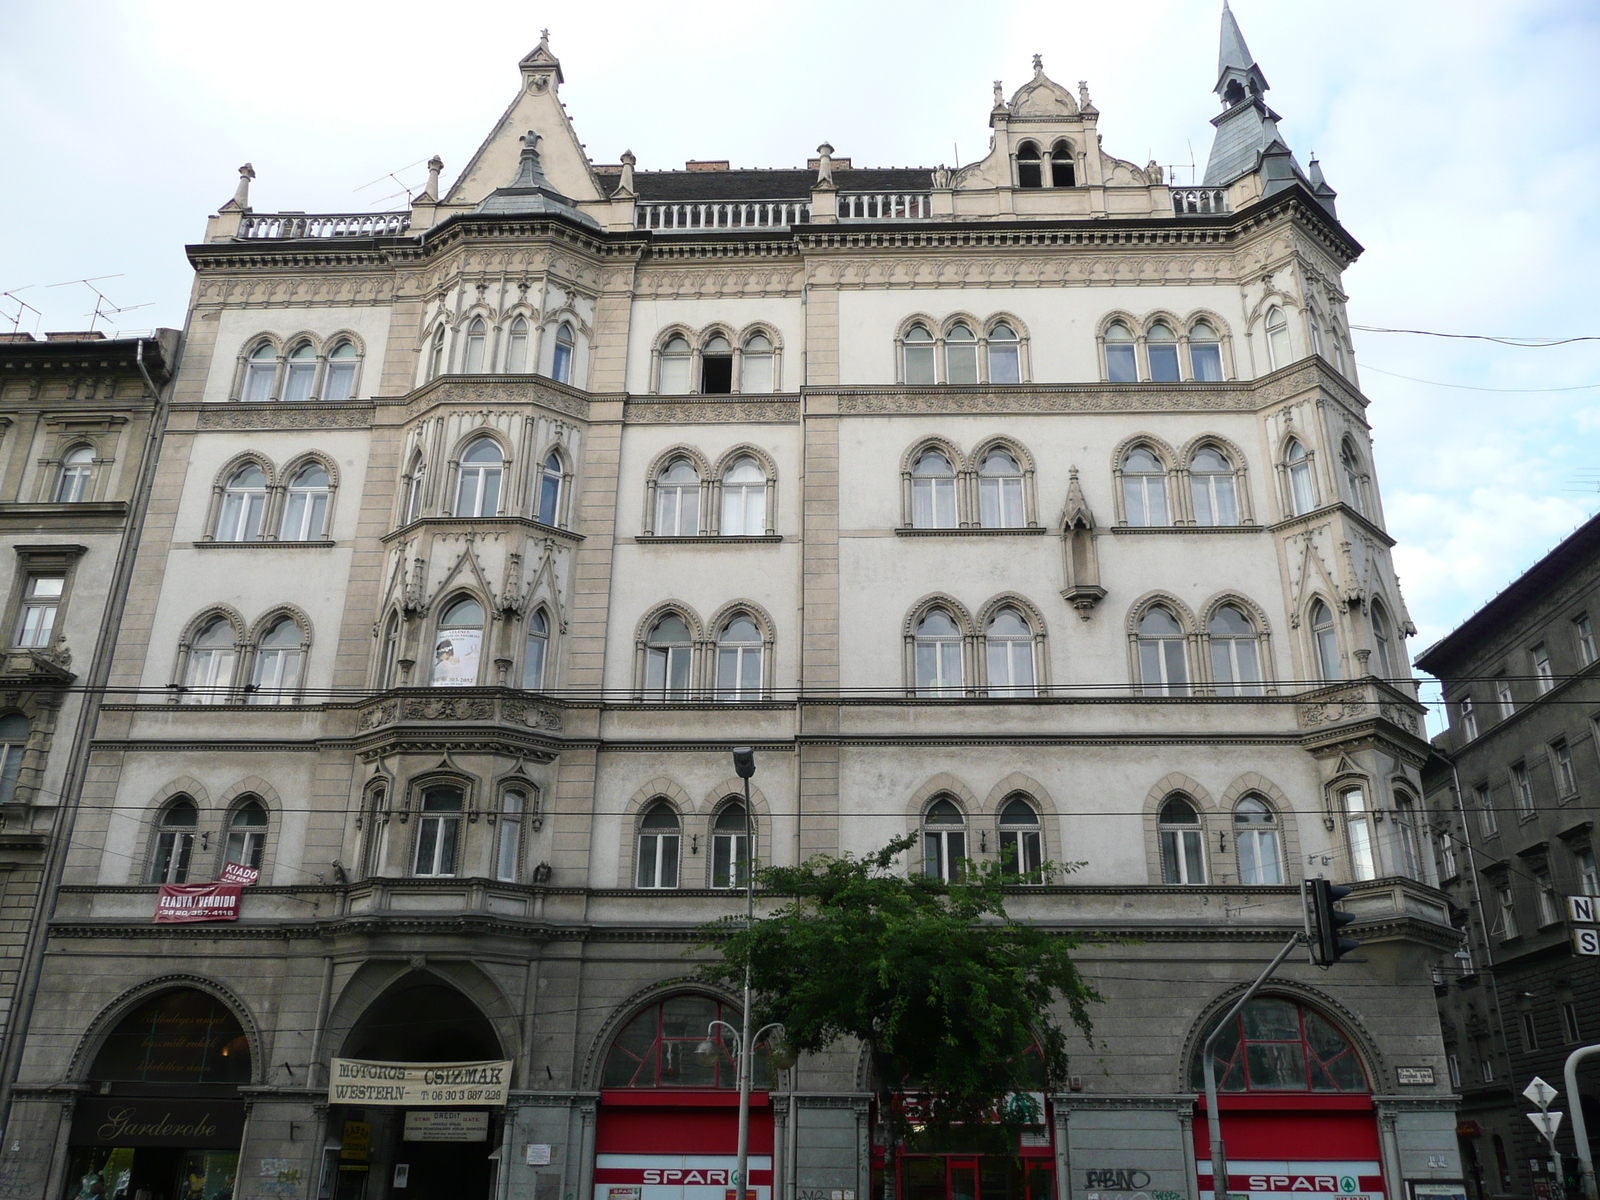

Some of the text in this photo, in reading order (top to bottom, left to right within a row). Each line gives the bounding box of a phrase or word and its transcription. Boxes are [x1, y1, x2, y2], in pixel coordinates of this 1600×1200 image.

[225, 863, 259, 879] KIADÓ
[1574, 899, 1591, 919] N
[1581, 932, 1596, 952] S
[338, 1063, 503, 1085] MOTOROS- CSIZMÁK
[335, 1084, 411, 1100] WESTERN-
[431, 1090, 443, 1100] 06
[445, 1090, 456, 1100] 30
[459, 1090, 465, 1100] 3
[484, 1090, 501, 1100] 228
[97, 1105, 217, 1140] Garderobe
[643, 1170, 726, 1185] SPAR
[1248, 1176, 1335, 1191] SPAR
